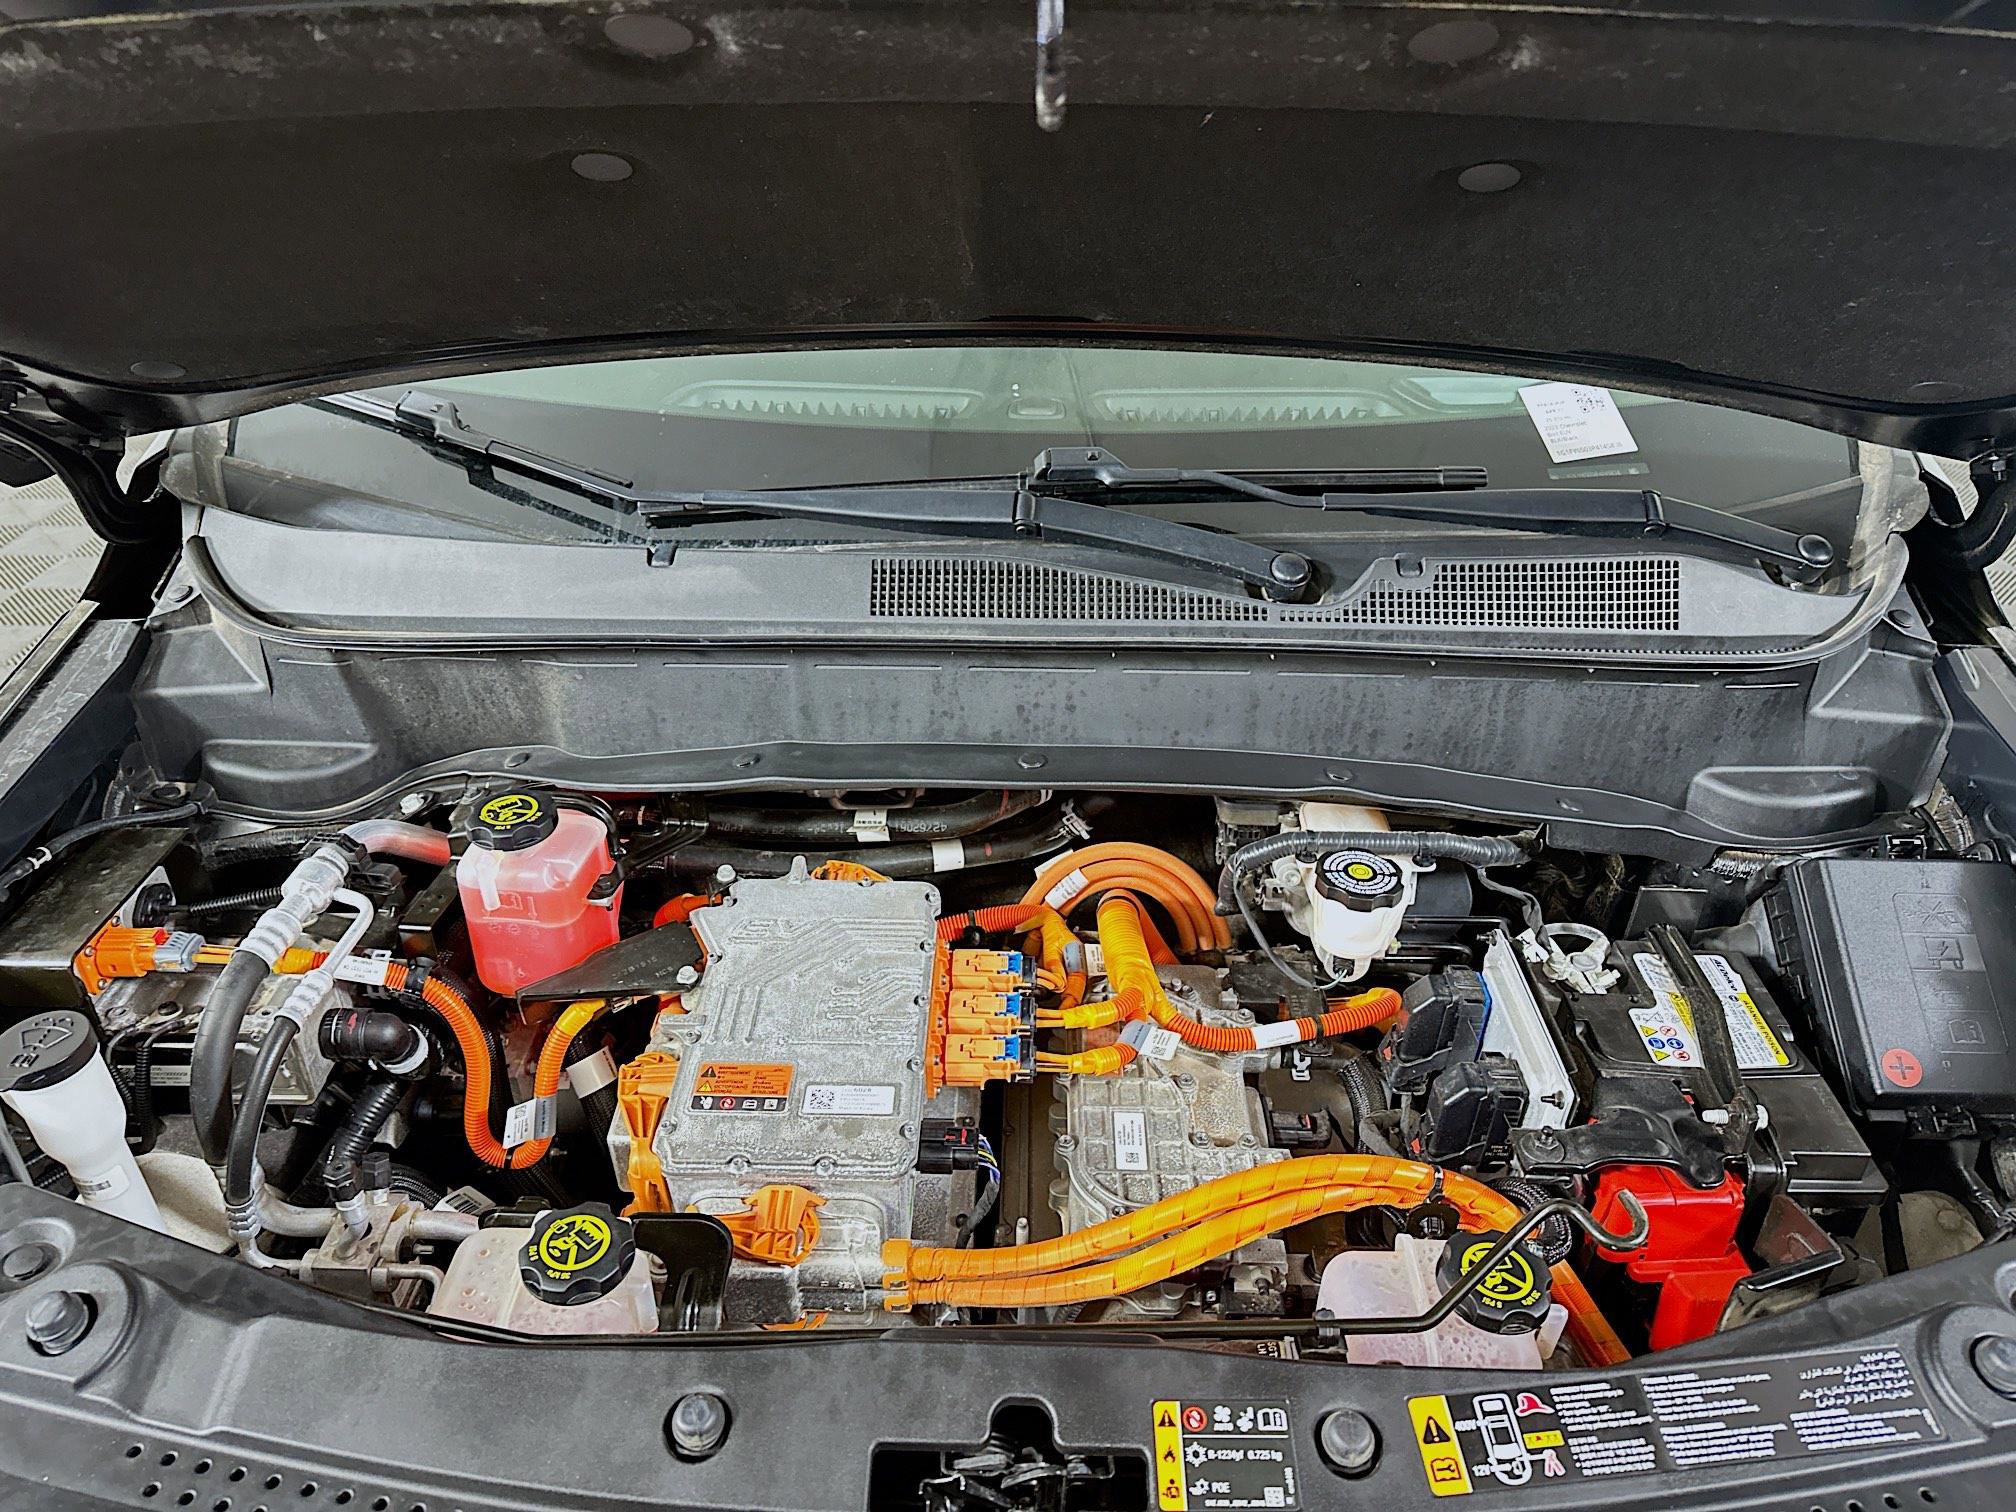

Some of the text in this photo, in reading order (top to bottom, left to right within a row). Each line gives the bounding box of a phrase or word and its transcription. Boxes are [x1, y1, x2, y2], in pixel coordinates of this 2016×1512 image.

[1746, 1004, 1763, 1031] DANGER
[1763, 1031, 1782, 1055] POISON
[1482, 1297, 1496, 1307] PSI
[1257, 1343, 1267, 1355] LH
[1267, 1341, 1278, 1358] SGT
[1271, 1449, 1283, 1462] kg
[1211, 1482, 1231, 1494] POE
